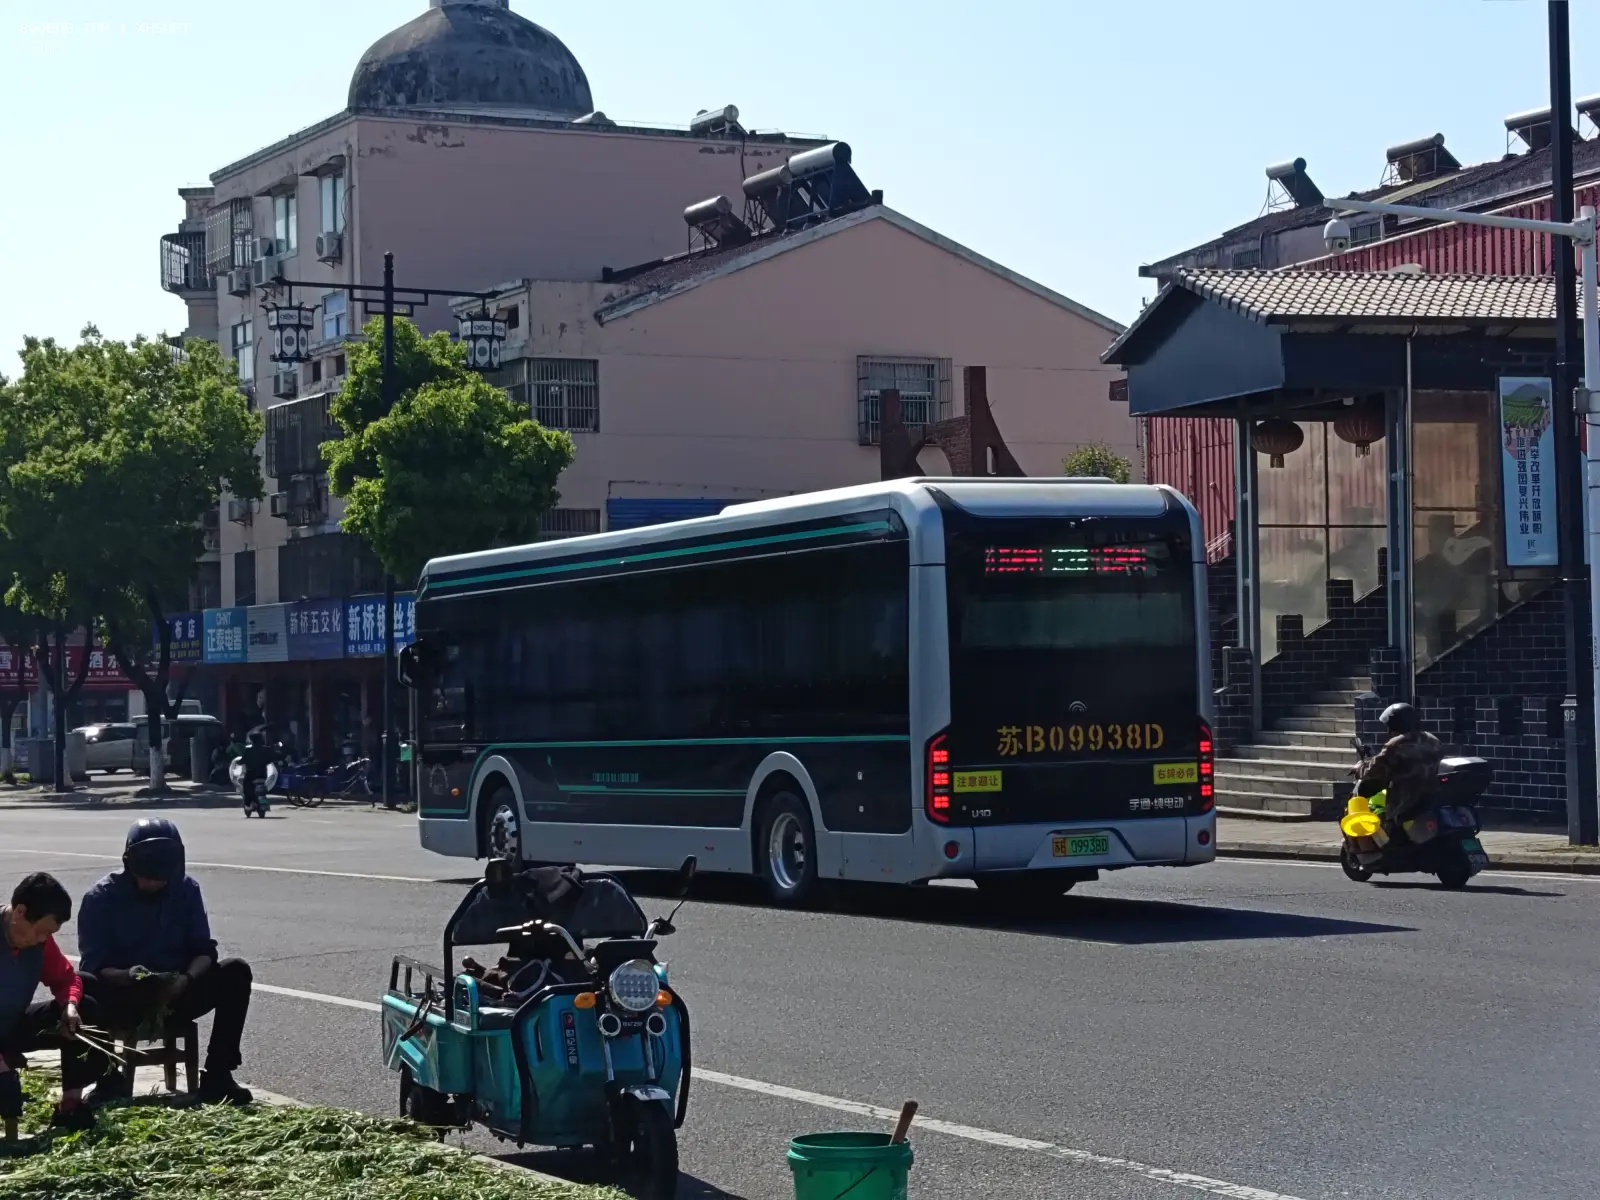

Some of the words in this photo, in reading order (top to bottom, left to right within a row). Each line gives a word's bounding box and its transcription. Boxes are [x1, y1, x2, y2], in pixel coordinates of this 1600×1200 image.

[289, 608, 341, 635] 新桥五交化
[207, 626, 242, 652] 正泰电器
[997, 723, 1164, 756] 苏B09938D
[956, 775, 999, 788] 注意避让
[1157, 767, 1195, 780] 右转必停
